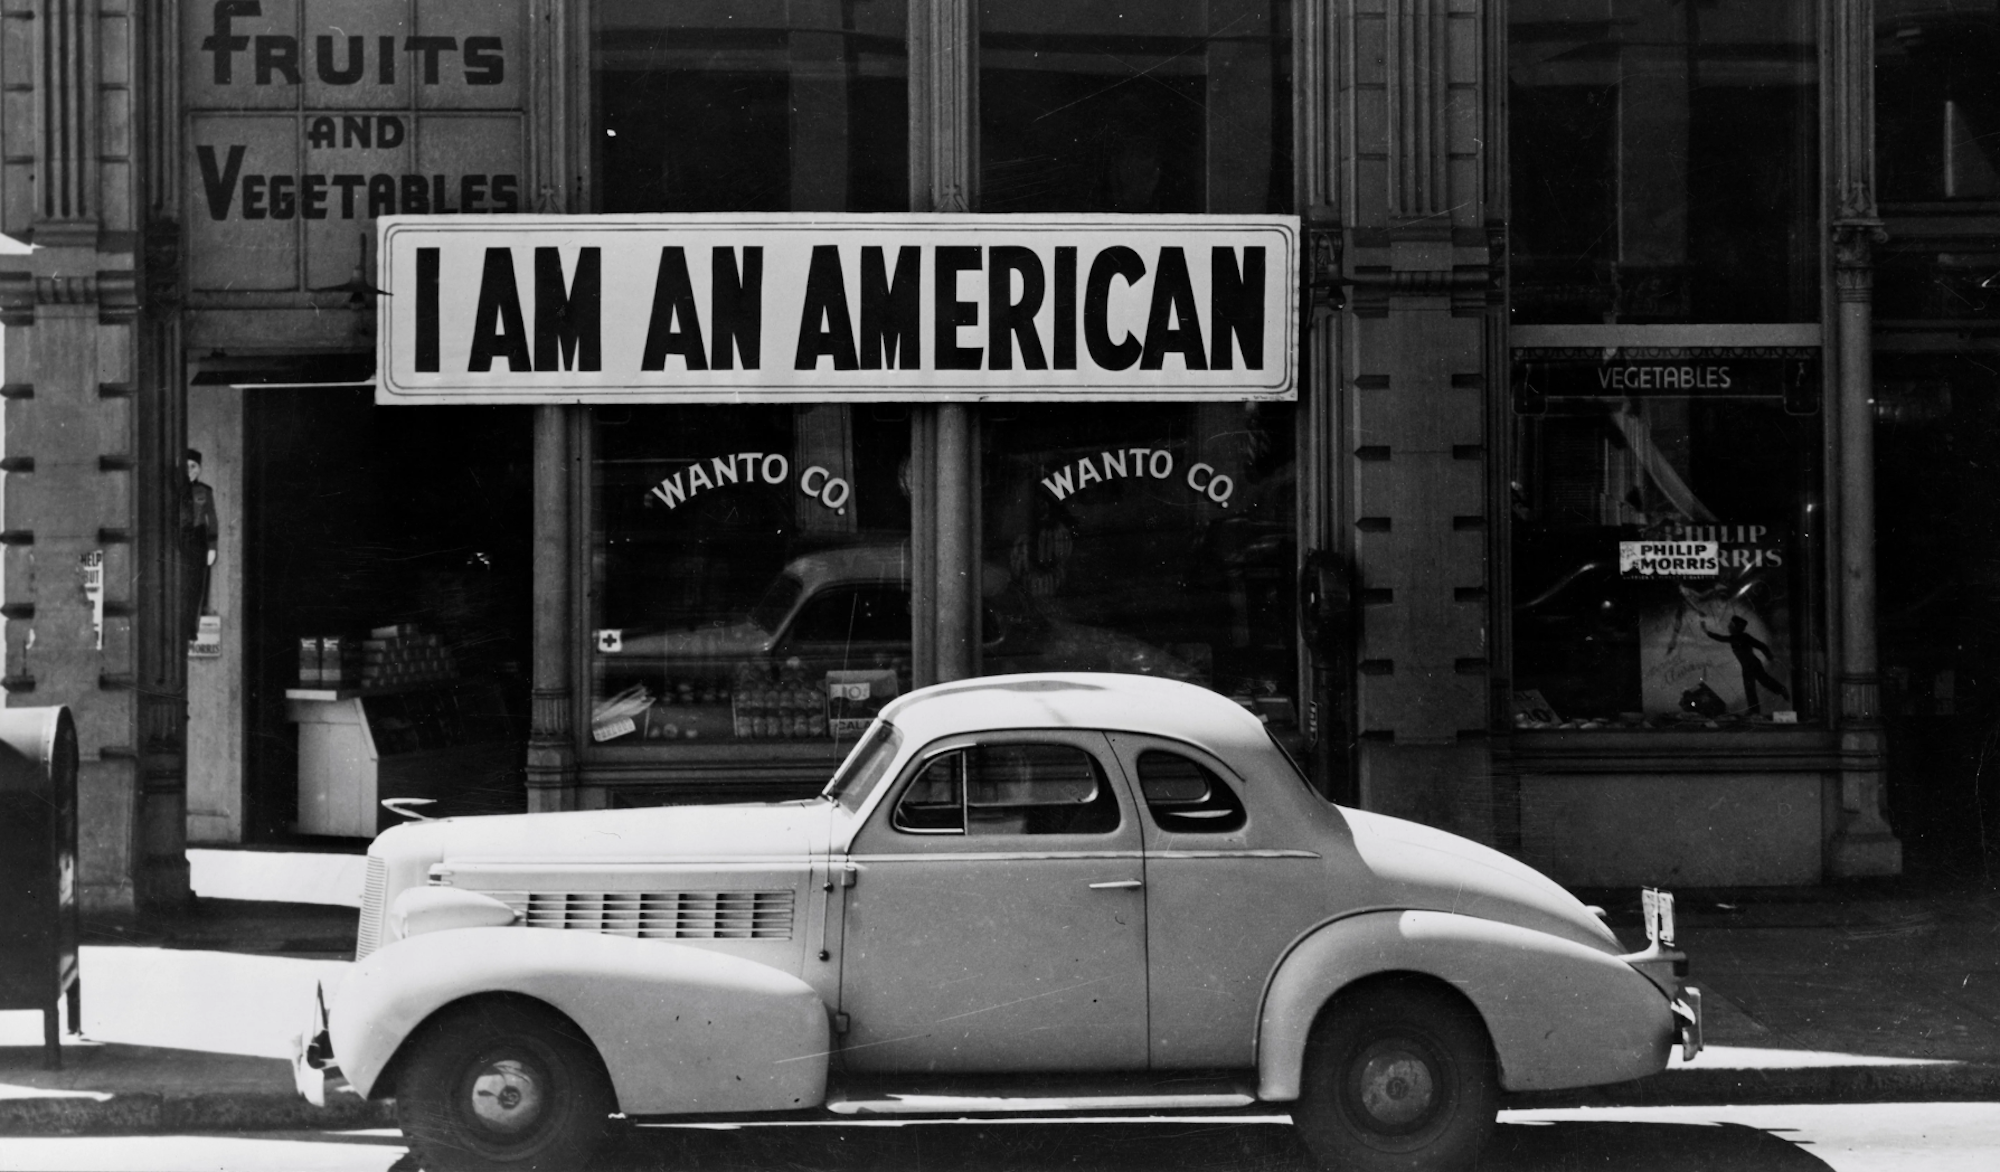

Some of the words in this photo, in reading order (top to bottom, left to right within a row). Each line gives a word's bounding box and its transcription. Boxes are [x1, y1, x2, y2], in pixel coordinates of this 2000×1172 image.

[201, 0, 505, 85] FRUITS
[307, 115, 405, 149] AND
[196, 144, 518, 221] VEGETABLES
[414, 246, 441, 373] I
[468, 246, 602, 373] AM
[640, 245, 764, 372] AN
[794, 244, 1267, 372] AMERICAN
[1597, 366, 1731, 389] VEGETABLES
[651, 452, 789, 510] WANTO
[801, 465, 850, 516] CO.
[1041, 448, 1174, 502] WANTO
[1187, 462, 1235, 509] CO.
[1640, 544, 1708, 556] PHILIP
[1640, 557, 1717, 570] MORRIS
[1718, 548, 1784, 568] RRIS
